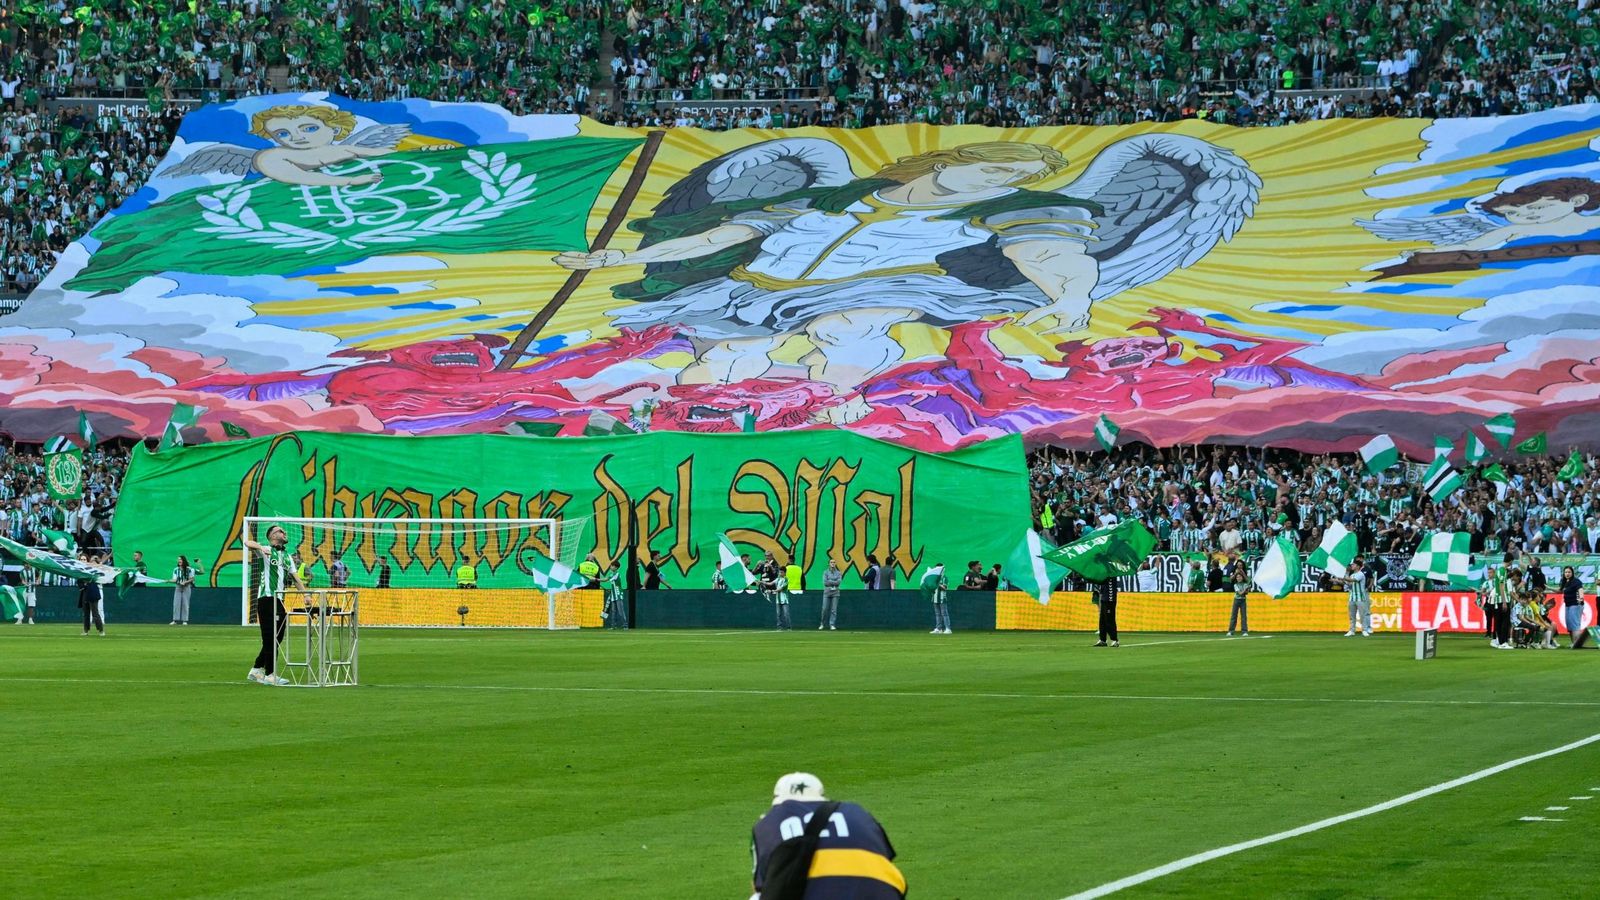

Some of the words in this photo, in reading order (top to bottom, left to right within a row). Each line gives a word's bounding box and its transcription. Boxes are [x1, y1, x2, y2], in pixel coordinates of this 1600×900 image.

[587, 453, 700, 578] del
[723, 455, 924, 582] Mal
[1357, 608, 1402, 629] evi
